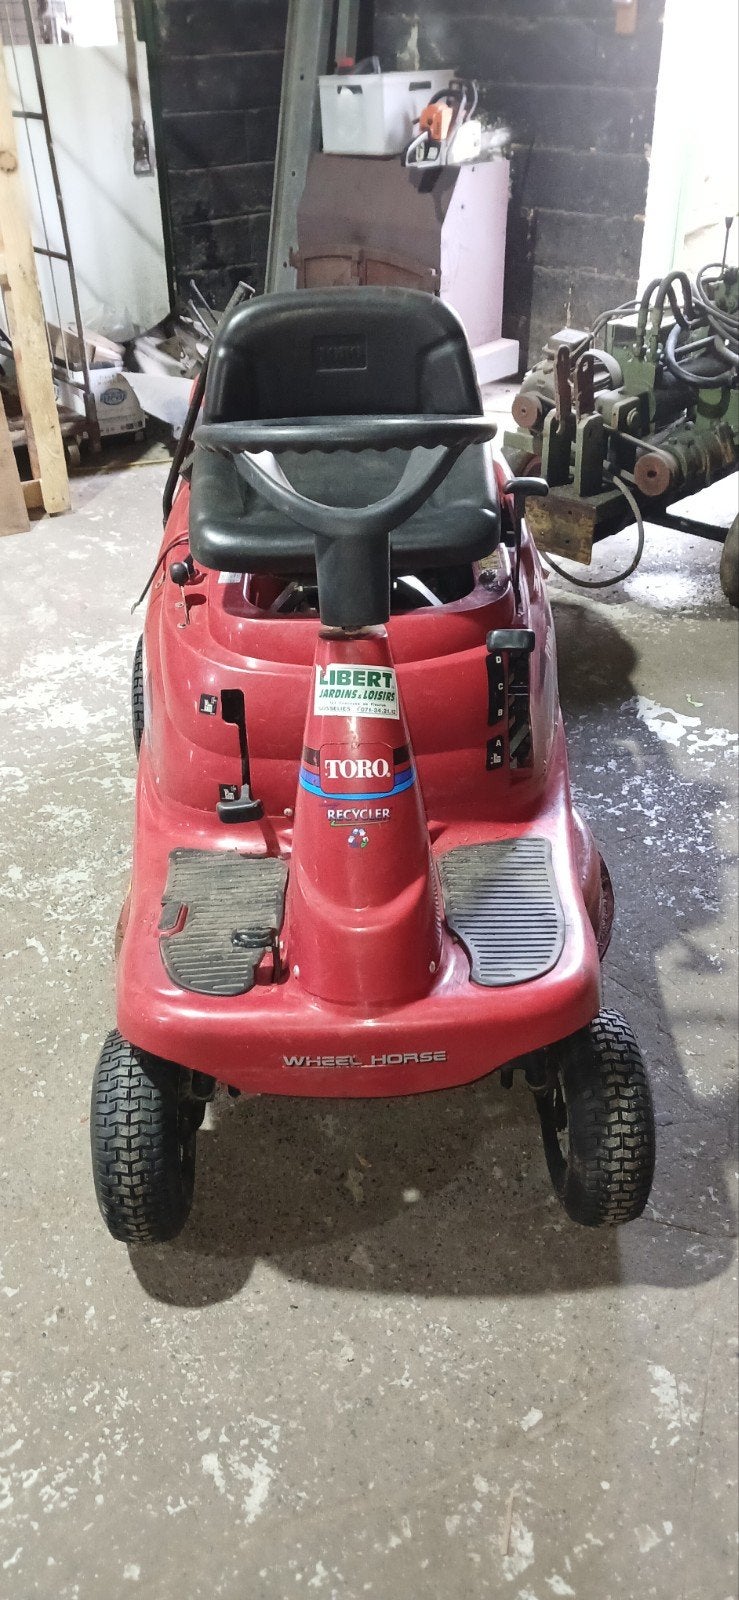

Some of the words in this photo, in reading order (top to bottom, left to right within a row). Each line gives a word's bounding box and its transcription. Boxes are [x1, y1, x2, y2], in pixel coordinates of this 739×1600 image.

[495, 656, 502, 664] D
[319, 670, 393, 688] LIBERT
[498, 682, 504, 691] C
[319, 689, 358, 699] JARDINS
[363, 690, 395, 701] LOISIRS
[327, 808, 390, 820] RECYCLER
[283, 1055, 362, 1067] WHEEL
[371, 1051, 447, 1065] HORSE
